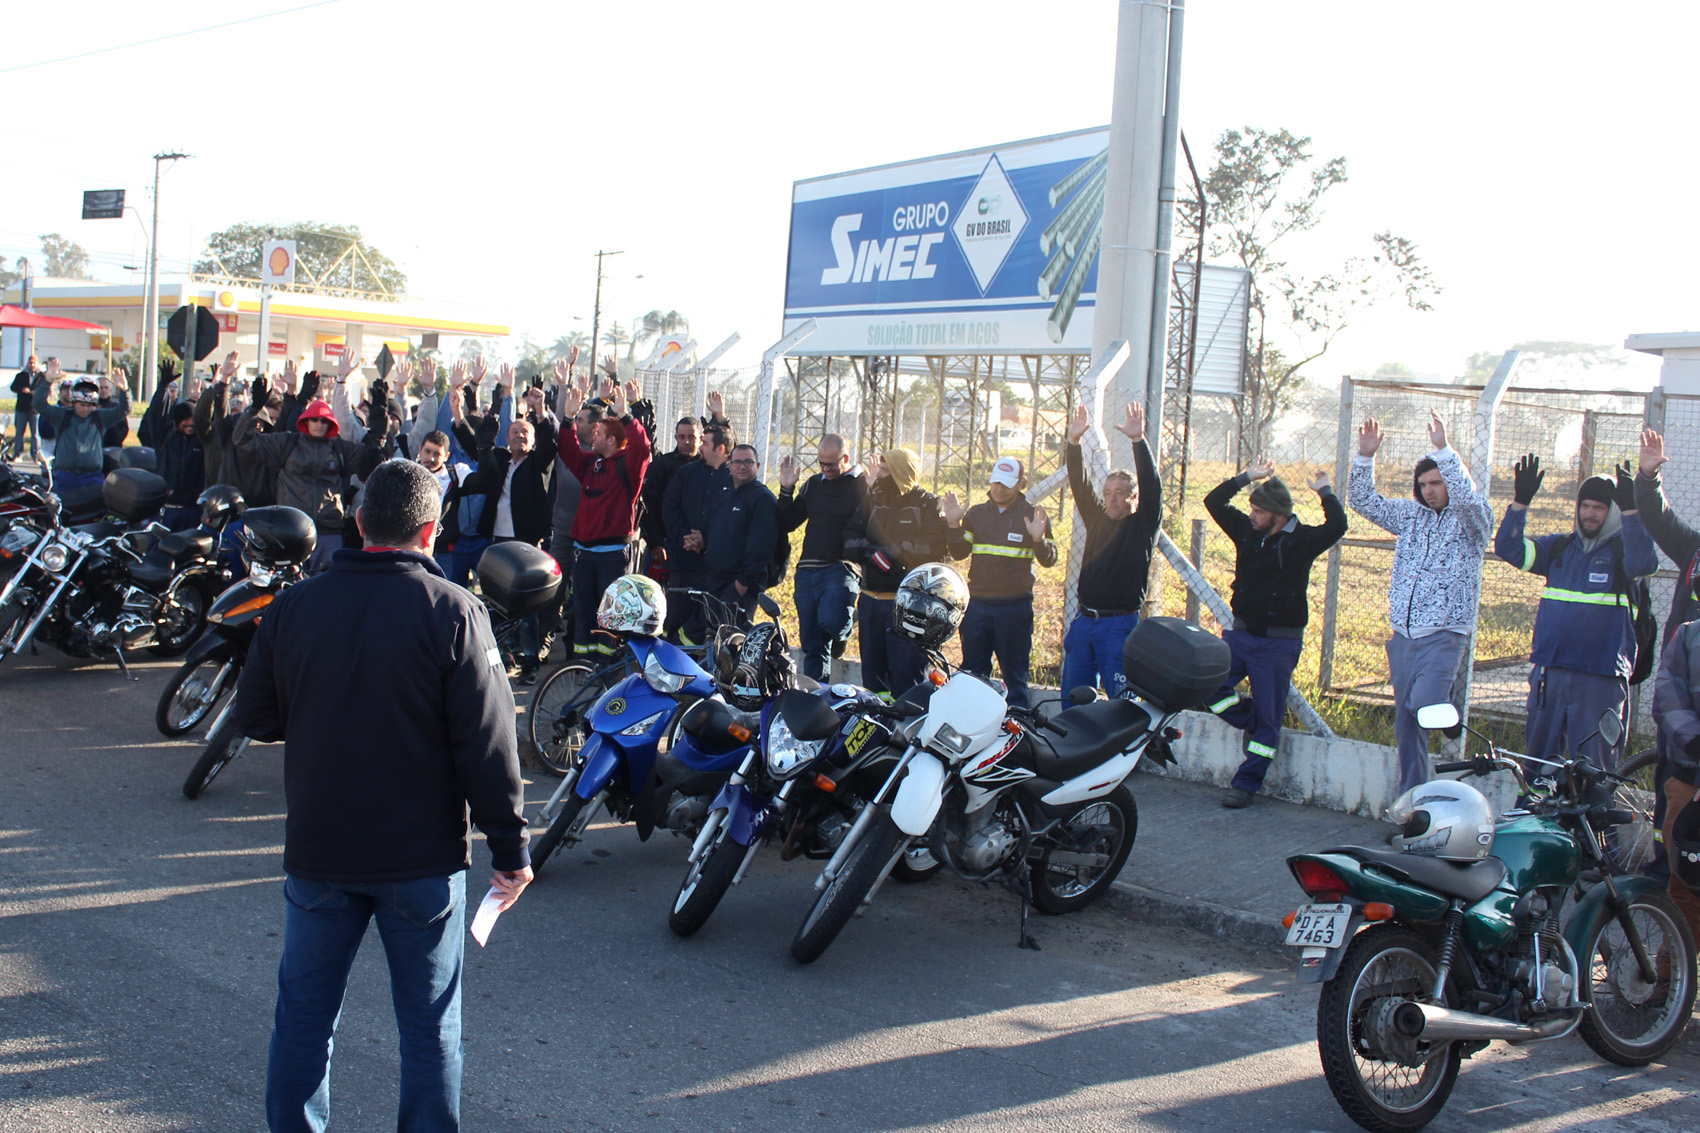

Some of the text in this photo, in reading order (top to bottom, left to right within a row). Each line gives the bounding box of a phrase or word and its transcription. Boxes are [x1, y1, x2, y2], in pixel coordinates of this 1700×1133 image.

[893, 201, 949, 231] GRUPO
[966, 219, 1011, 237] GV DO BRASIL
[820, 213, 945, 286] SIMEC
[867, 321, 914, 349] SOLUÇÃO
[916, 324, 946, 345] TOTAL
[949, 323, 966, 345] EM
[1300, 916, 1335, 930] DFA
[1295, 930, 1335, 943] 7463
